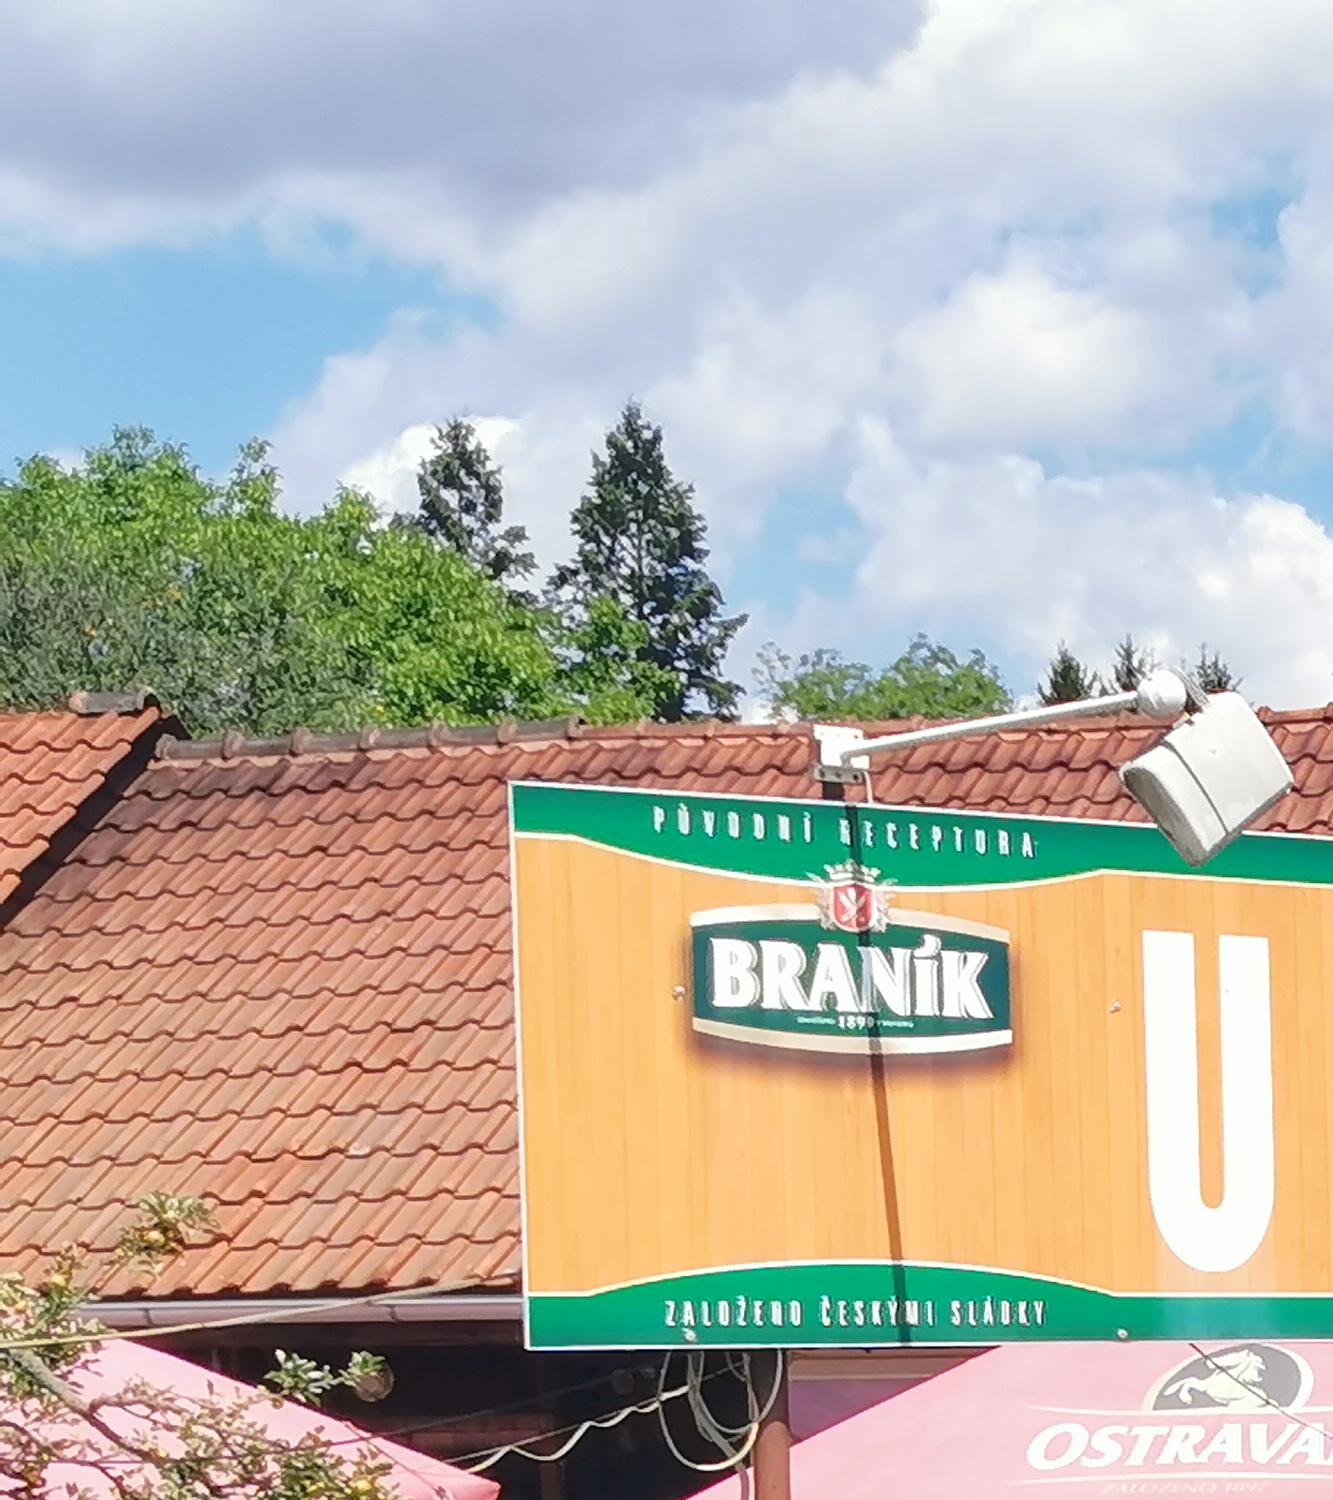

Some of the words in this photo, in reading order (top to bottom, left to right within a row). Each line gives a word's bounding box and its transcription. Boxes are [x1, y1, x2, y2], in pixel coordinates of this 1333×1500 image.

[839, 818, 1035, 858] RECEPTURA
[709, 934, 994, 1020] BRANÍK
[1143, 930, 1273, 1273] U
[665, 1295, 802, 1328] ZALOŽENO
[820, 1294, 936, 1327] ČESKÝMI
[951, 1295, 1046, 1327] SLÁDKY
